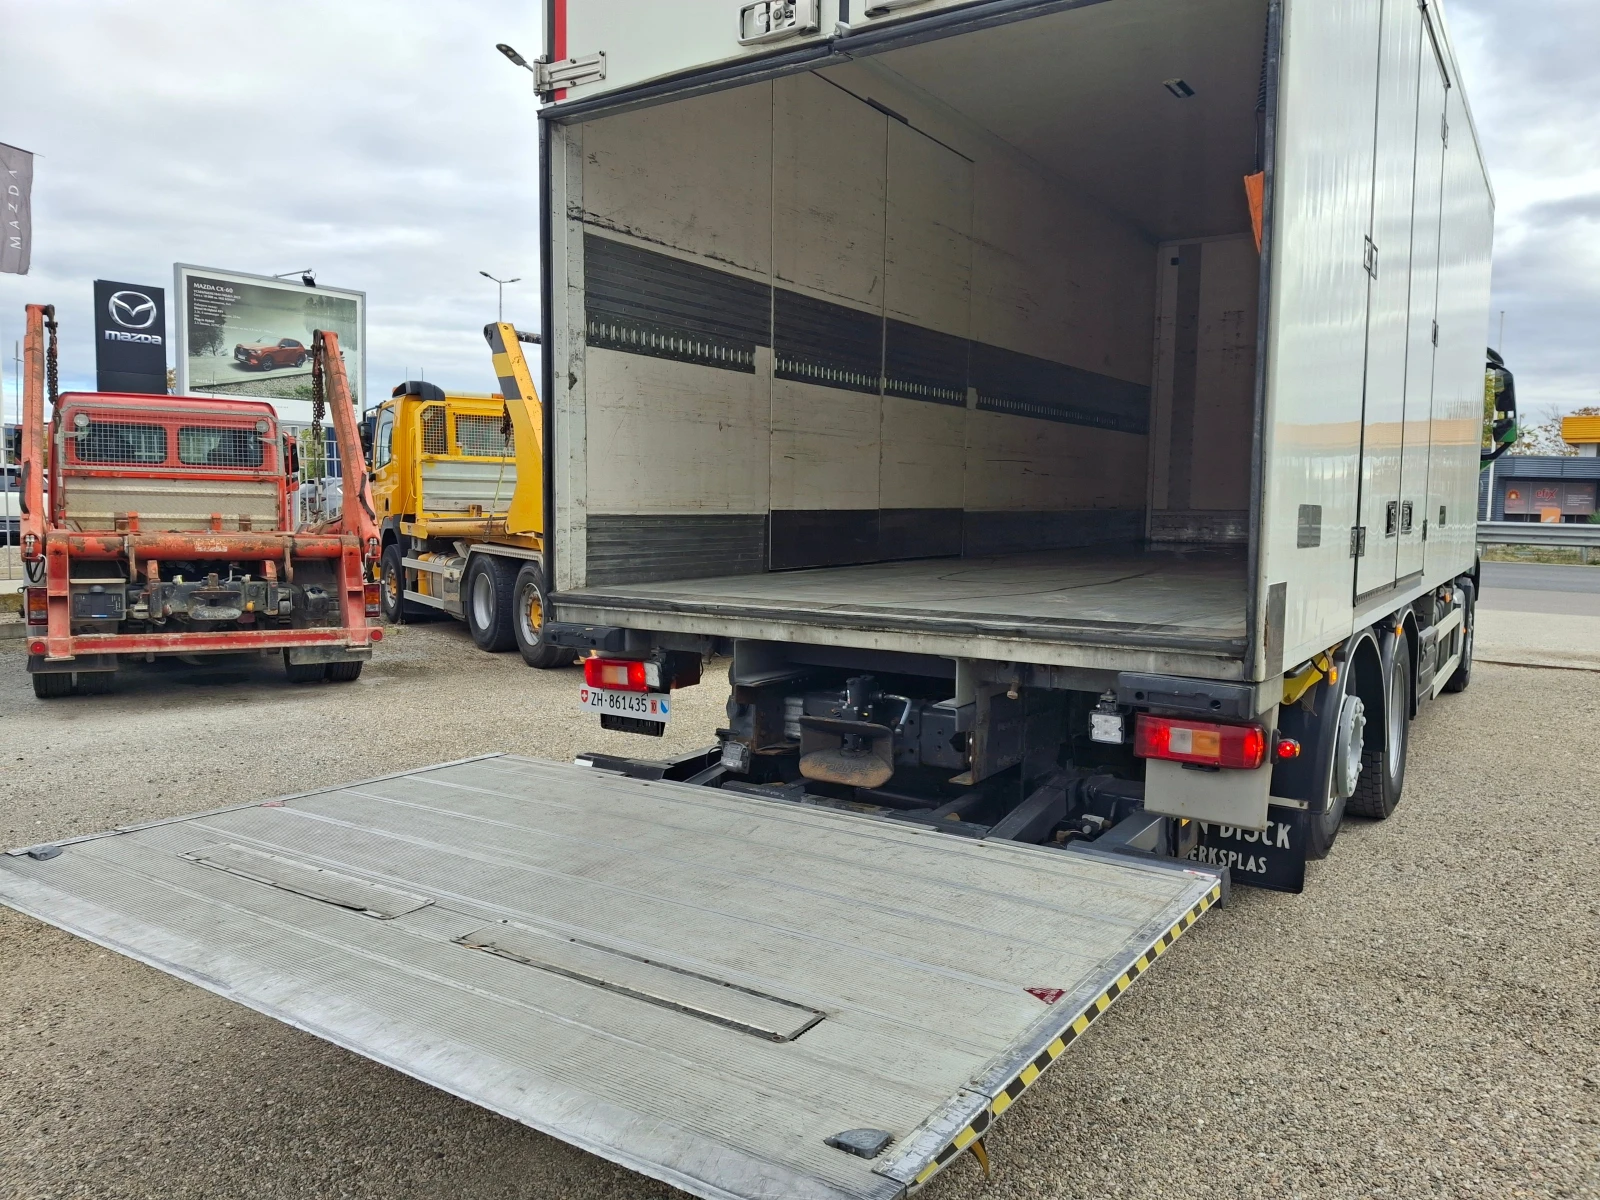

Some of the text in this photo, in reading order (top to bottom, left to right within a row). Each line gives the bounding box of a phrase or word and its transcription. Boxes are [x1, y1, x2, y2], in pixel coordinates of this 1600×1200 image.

[8, 169, 22, 250] MAZDA
[193, 282, 215, 291] MAZDA
[104, 329, 162, 345] mazda
[1187, 845, 1268, 874] ERKSPLAS
